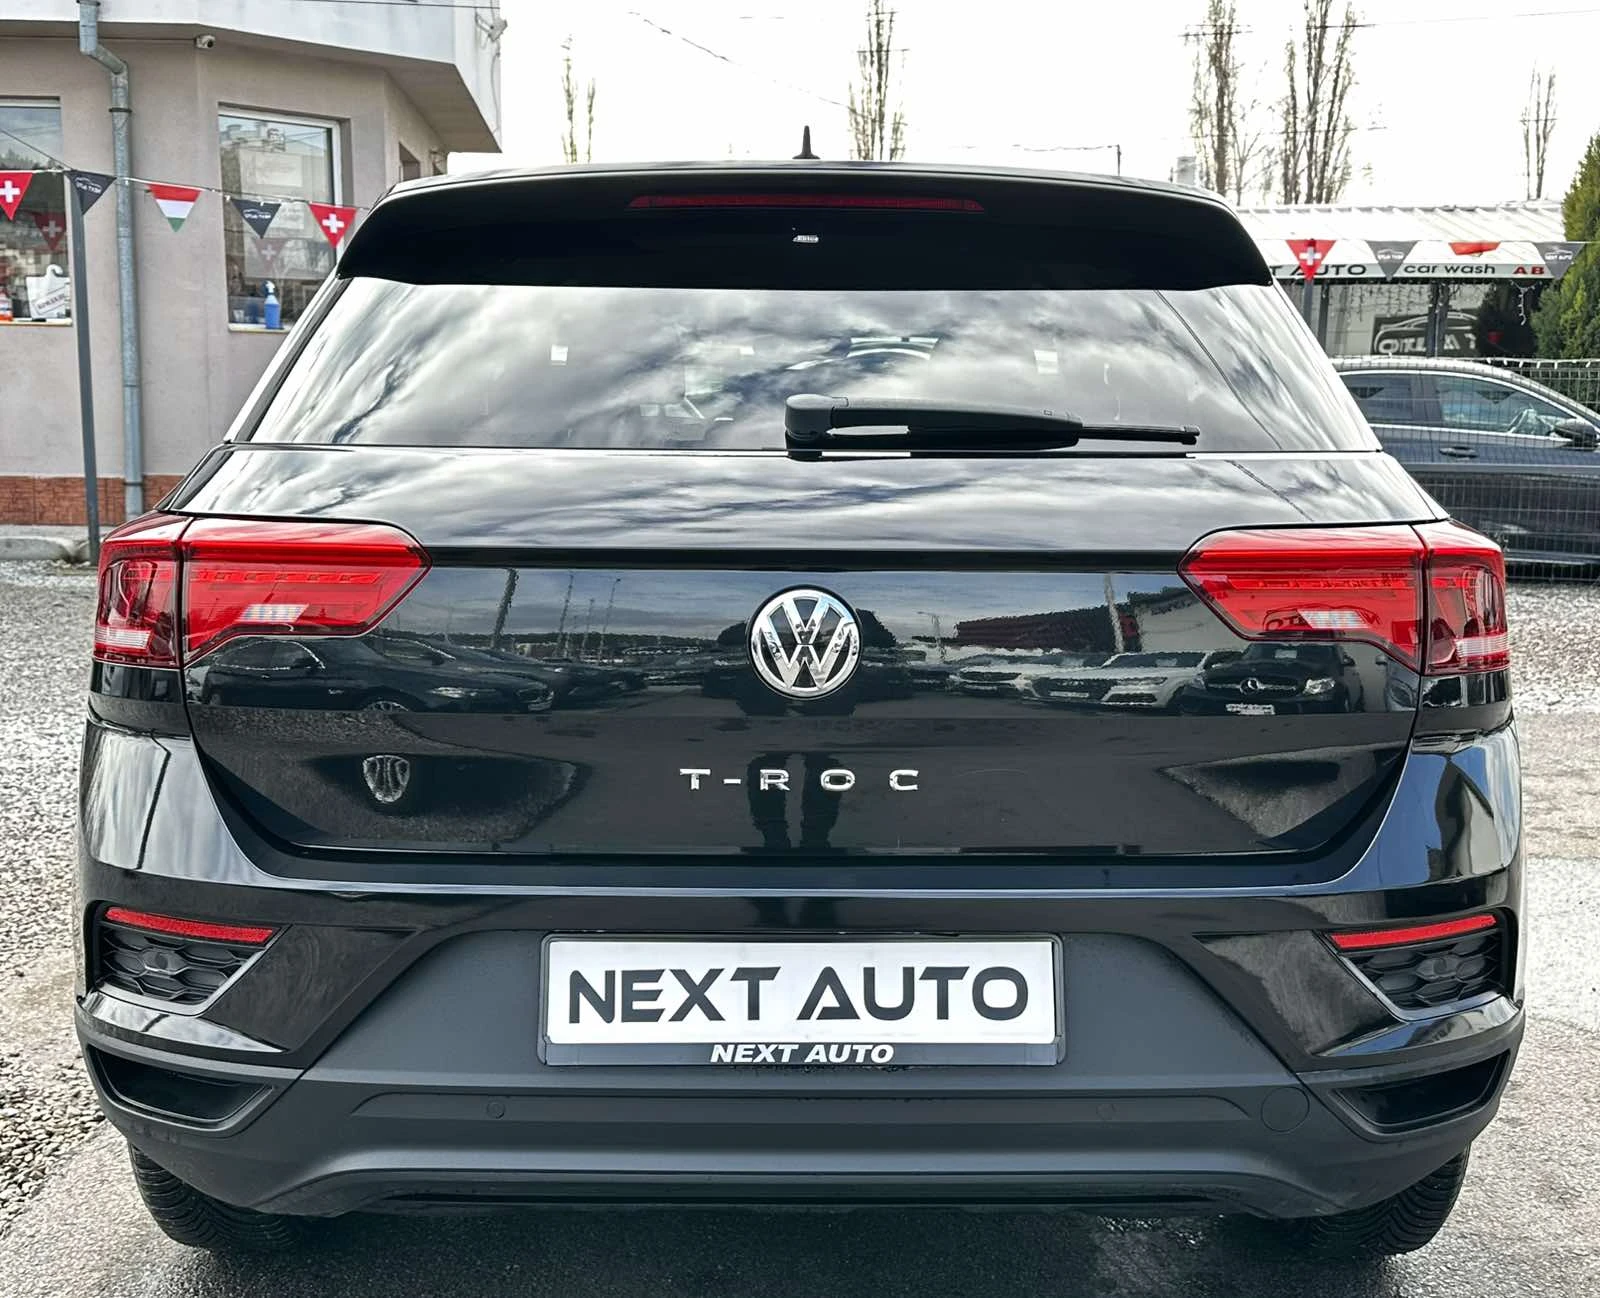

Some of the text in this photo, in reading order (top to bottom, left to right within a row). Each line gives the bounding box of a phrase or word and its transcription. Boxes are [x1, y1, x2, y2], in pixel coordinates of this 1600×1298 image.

[1403, 265, 1436, 275] car
[1444, 264, 1496, 275] wash
[568, 965, 1029, 1024] NEXT AUTO
[710, 1044, 896, 1064] NEXT AUTO
